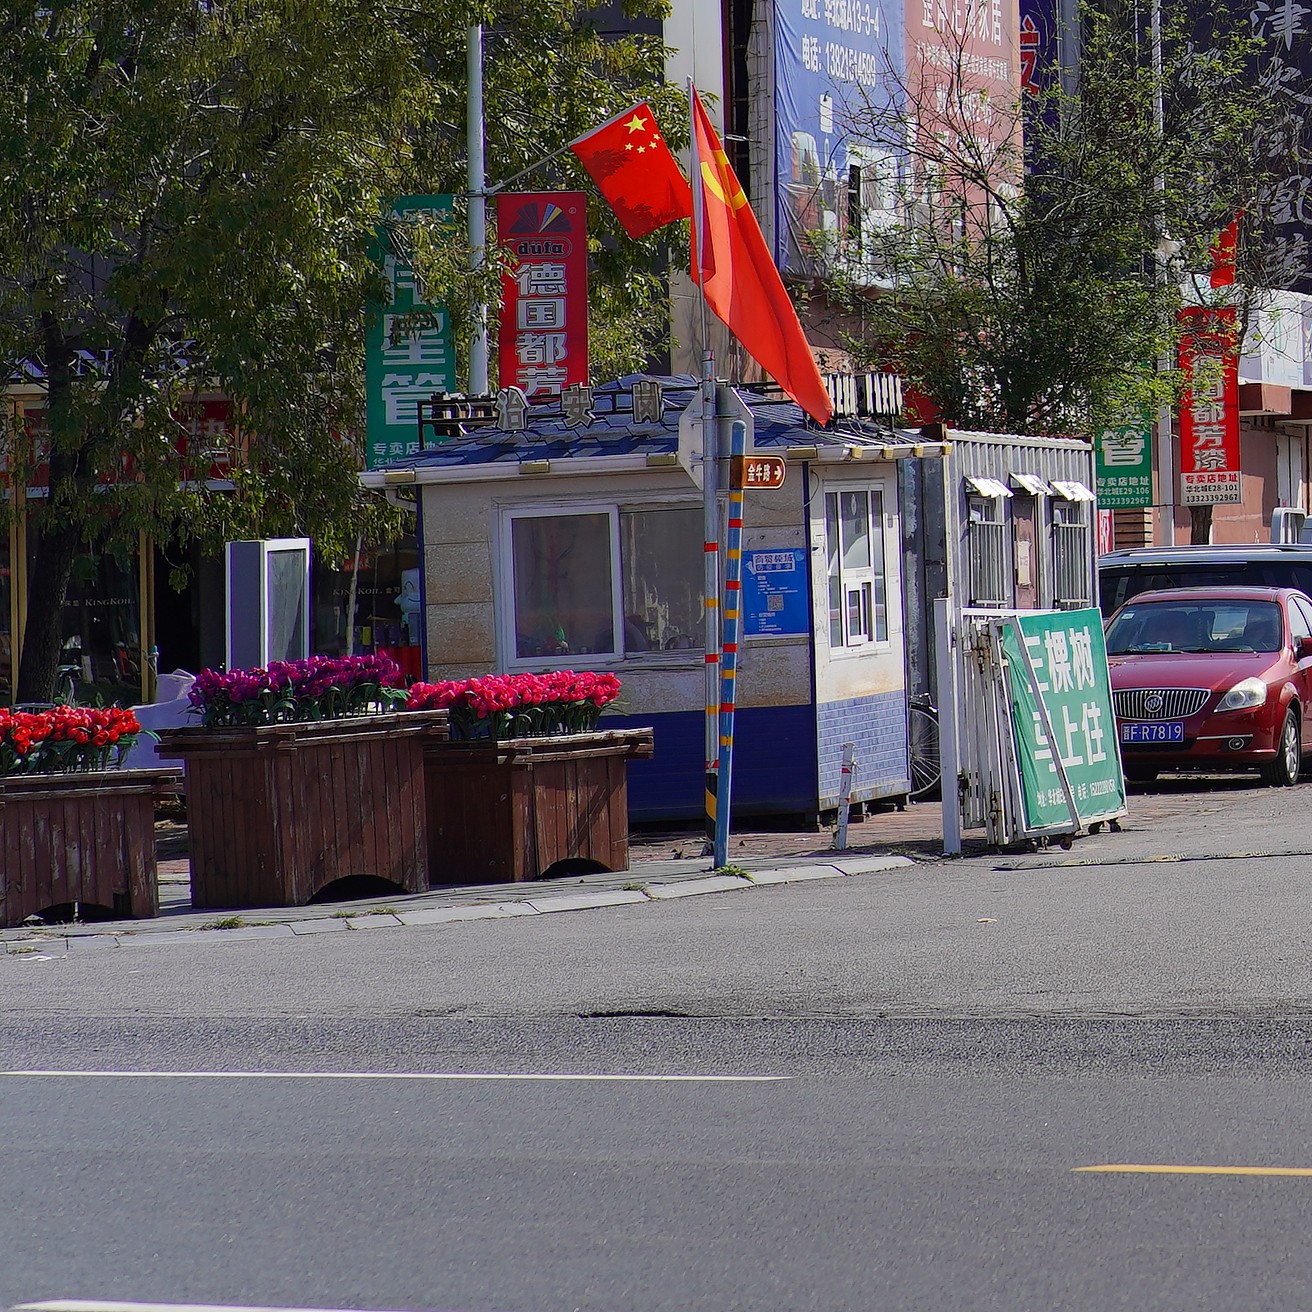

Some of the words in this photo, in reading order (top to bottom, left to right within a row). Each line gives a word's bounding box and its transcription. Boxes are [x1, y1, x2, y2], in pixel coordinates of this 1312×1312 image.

[518, 242, 564, 255] düfa
[747, 463, 771, 482] 金牛路
[1185, 473, 1239, 484] 专卖店地址
[1185, 494, 1239, 504] 13323392967
[1025, 625, 1096, 694] 三棵树
